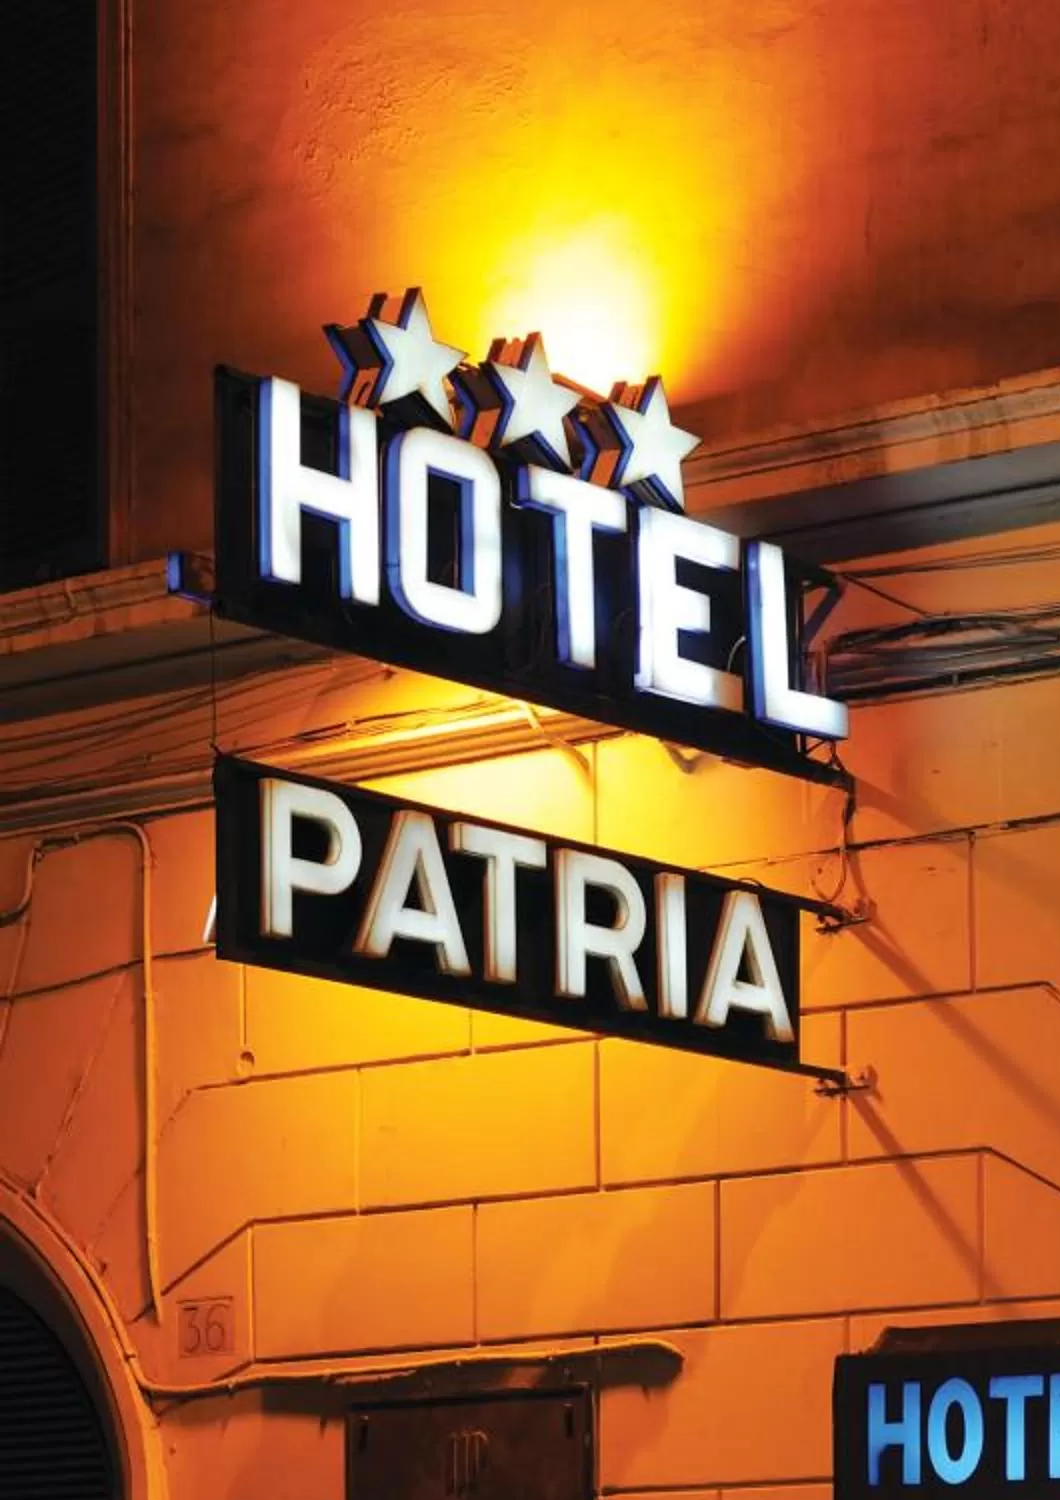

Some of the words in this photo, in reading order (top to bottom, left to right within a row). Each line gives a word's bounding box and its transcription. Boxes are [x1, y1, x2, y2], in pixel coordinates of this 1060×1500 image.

[259, 376, 849, 740] HOTEL
[260, 778, 796, 1043] PATRIA
[181, 1303, 230, 1353] 36
